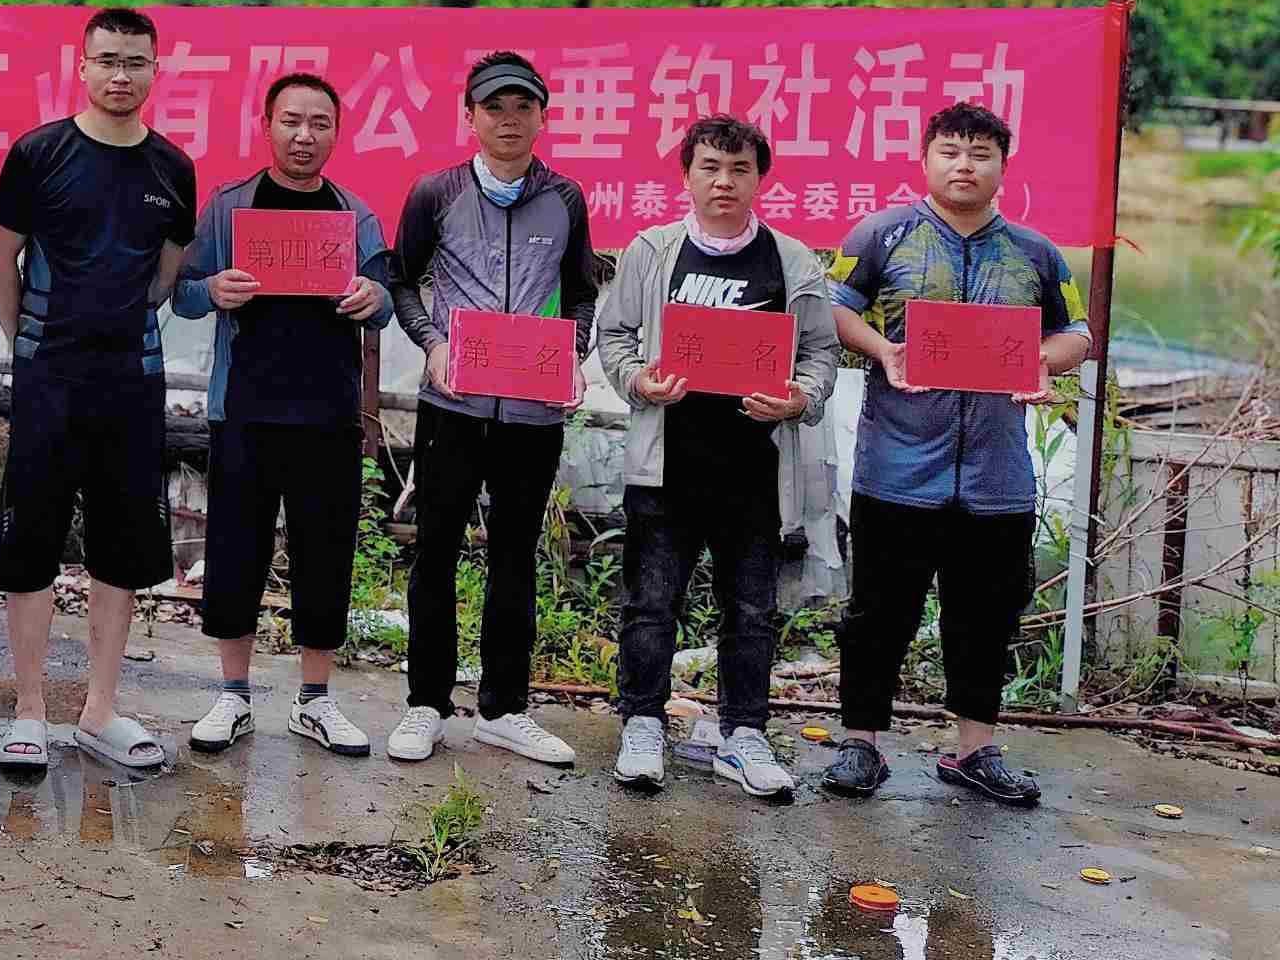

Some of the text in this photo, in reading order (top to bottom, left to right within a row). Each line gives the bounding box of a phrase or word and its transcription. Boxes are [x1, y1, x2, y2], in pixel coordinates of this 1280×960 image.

[244, 234, 345, 271] 第四名
[675, 272, 749, 308] NIKE
[462, 336, 560, 377] 第三名
[673, 330, 777, 375] 第二名
[919, 329, 1024, 368] 第一名
